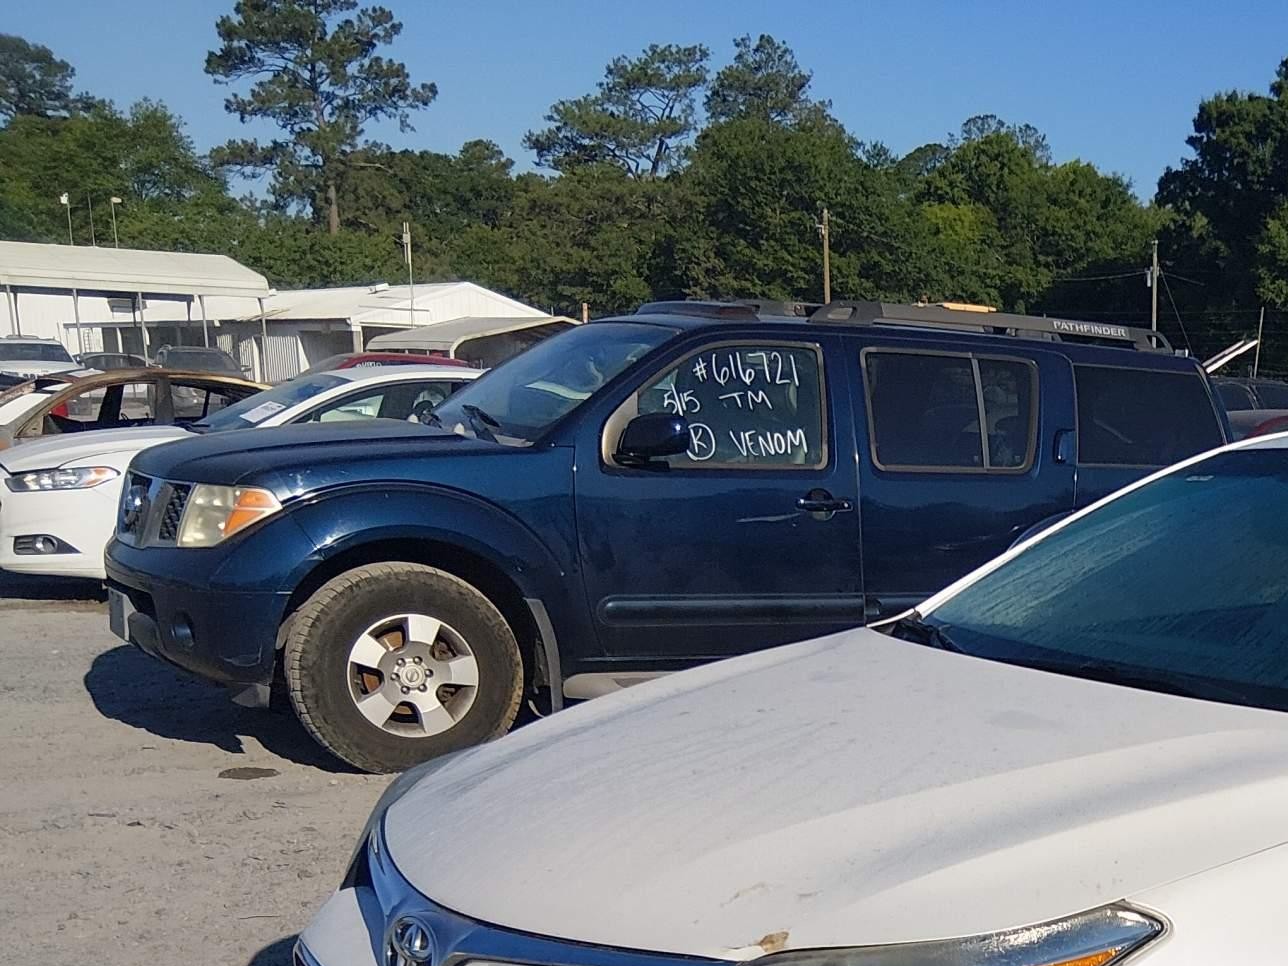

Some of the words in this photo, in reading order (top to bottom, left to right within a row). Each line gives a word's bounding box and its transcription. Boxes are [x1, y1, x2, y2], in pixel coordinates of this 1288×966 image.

[1053, 320, 1126, 337] PATHFINDER
[692, 352, 799, 387] #616721
[663, 383, 701, 417] 5/15
[718, 390, 773, 410] TM
[729, 428, 808, 457] VENOM
